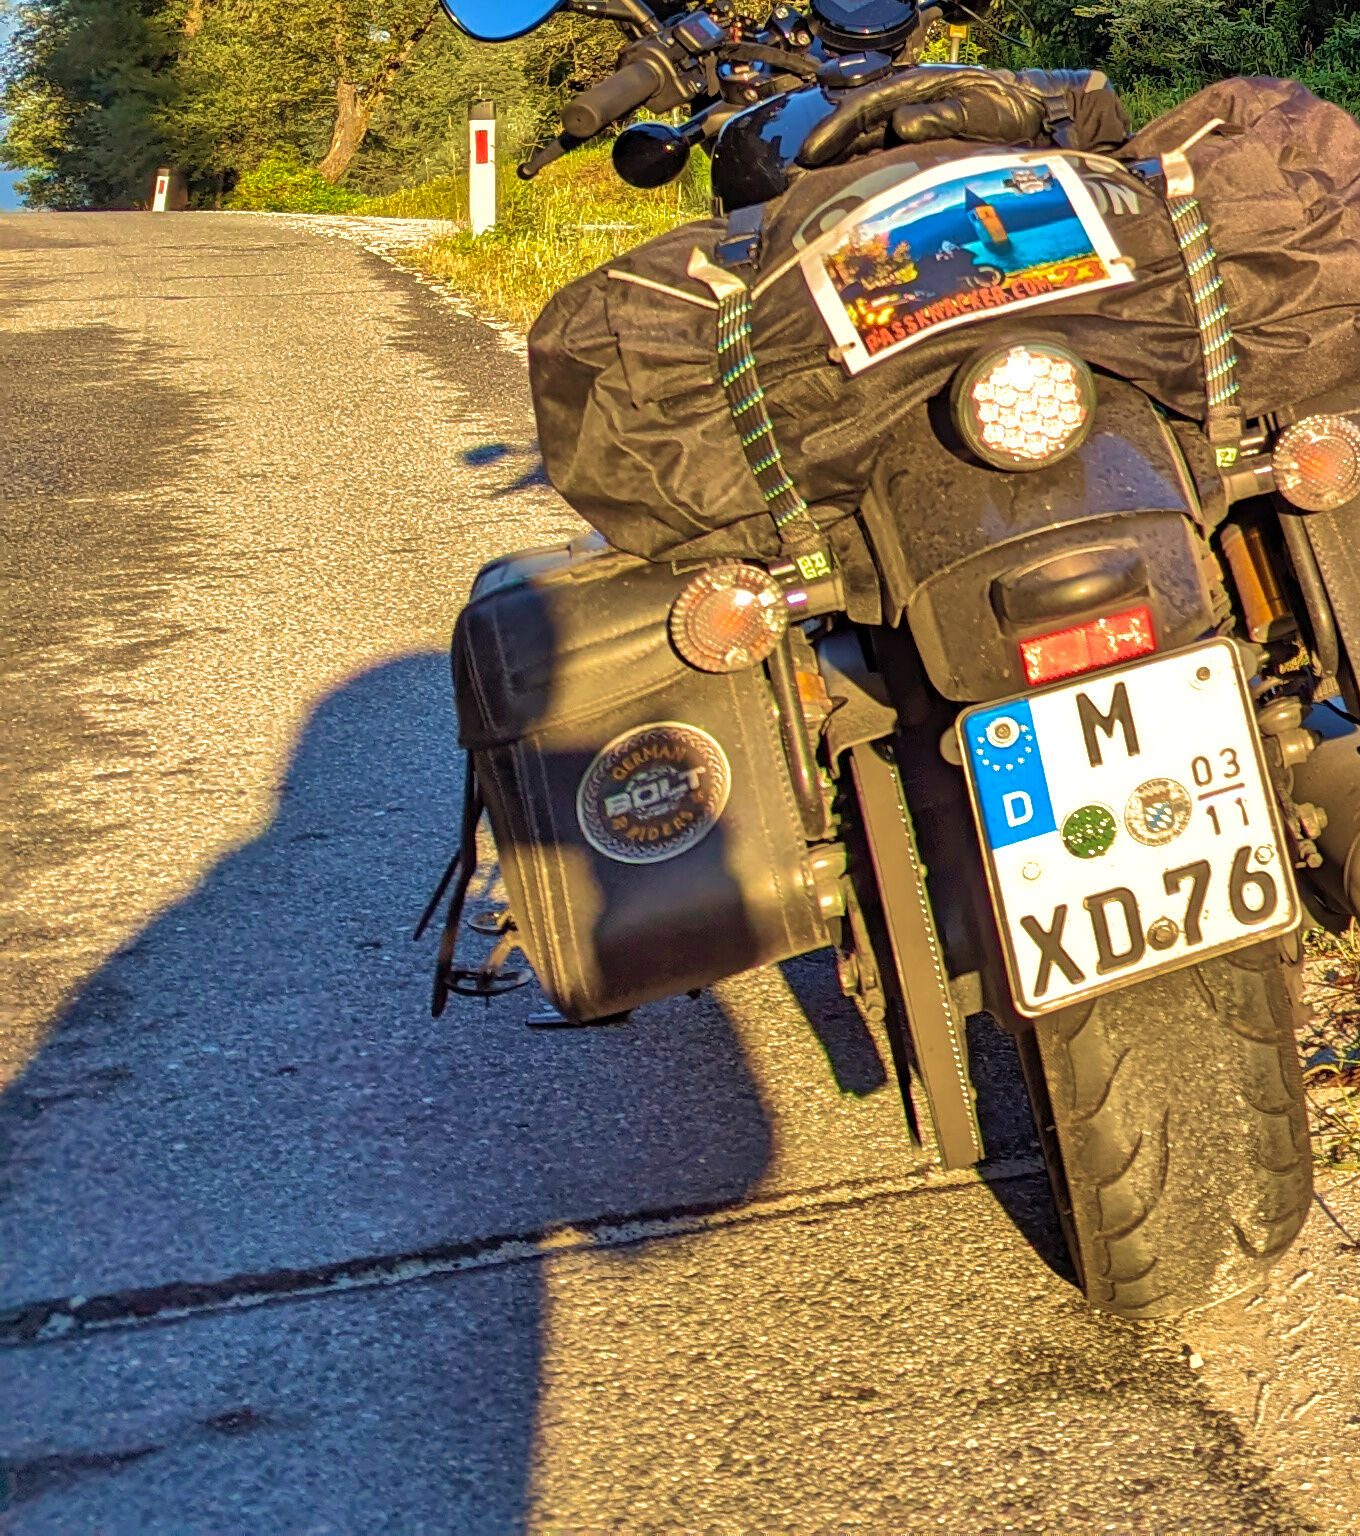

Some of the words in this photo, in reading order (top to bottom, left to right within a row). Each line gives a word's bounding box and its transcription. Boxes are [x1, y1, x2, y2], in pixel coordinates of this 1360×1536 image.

[865, 276, 1053, 354] PASSKNACKER.COM
[1075, 681, 1141, 767] M
[1191, 747, 1241, 787] 03
[603, 766, 705, 818] BOLT
[1003, 790, 1034, 828] D
[625, 810, 695, 841] RIDERS
[1206, 797, 1249, 835] 11
